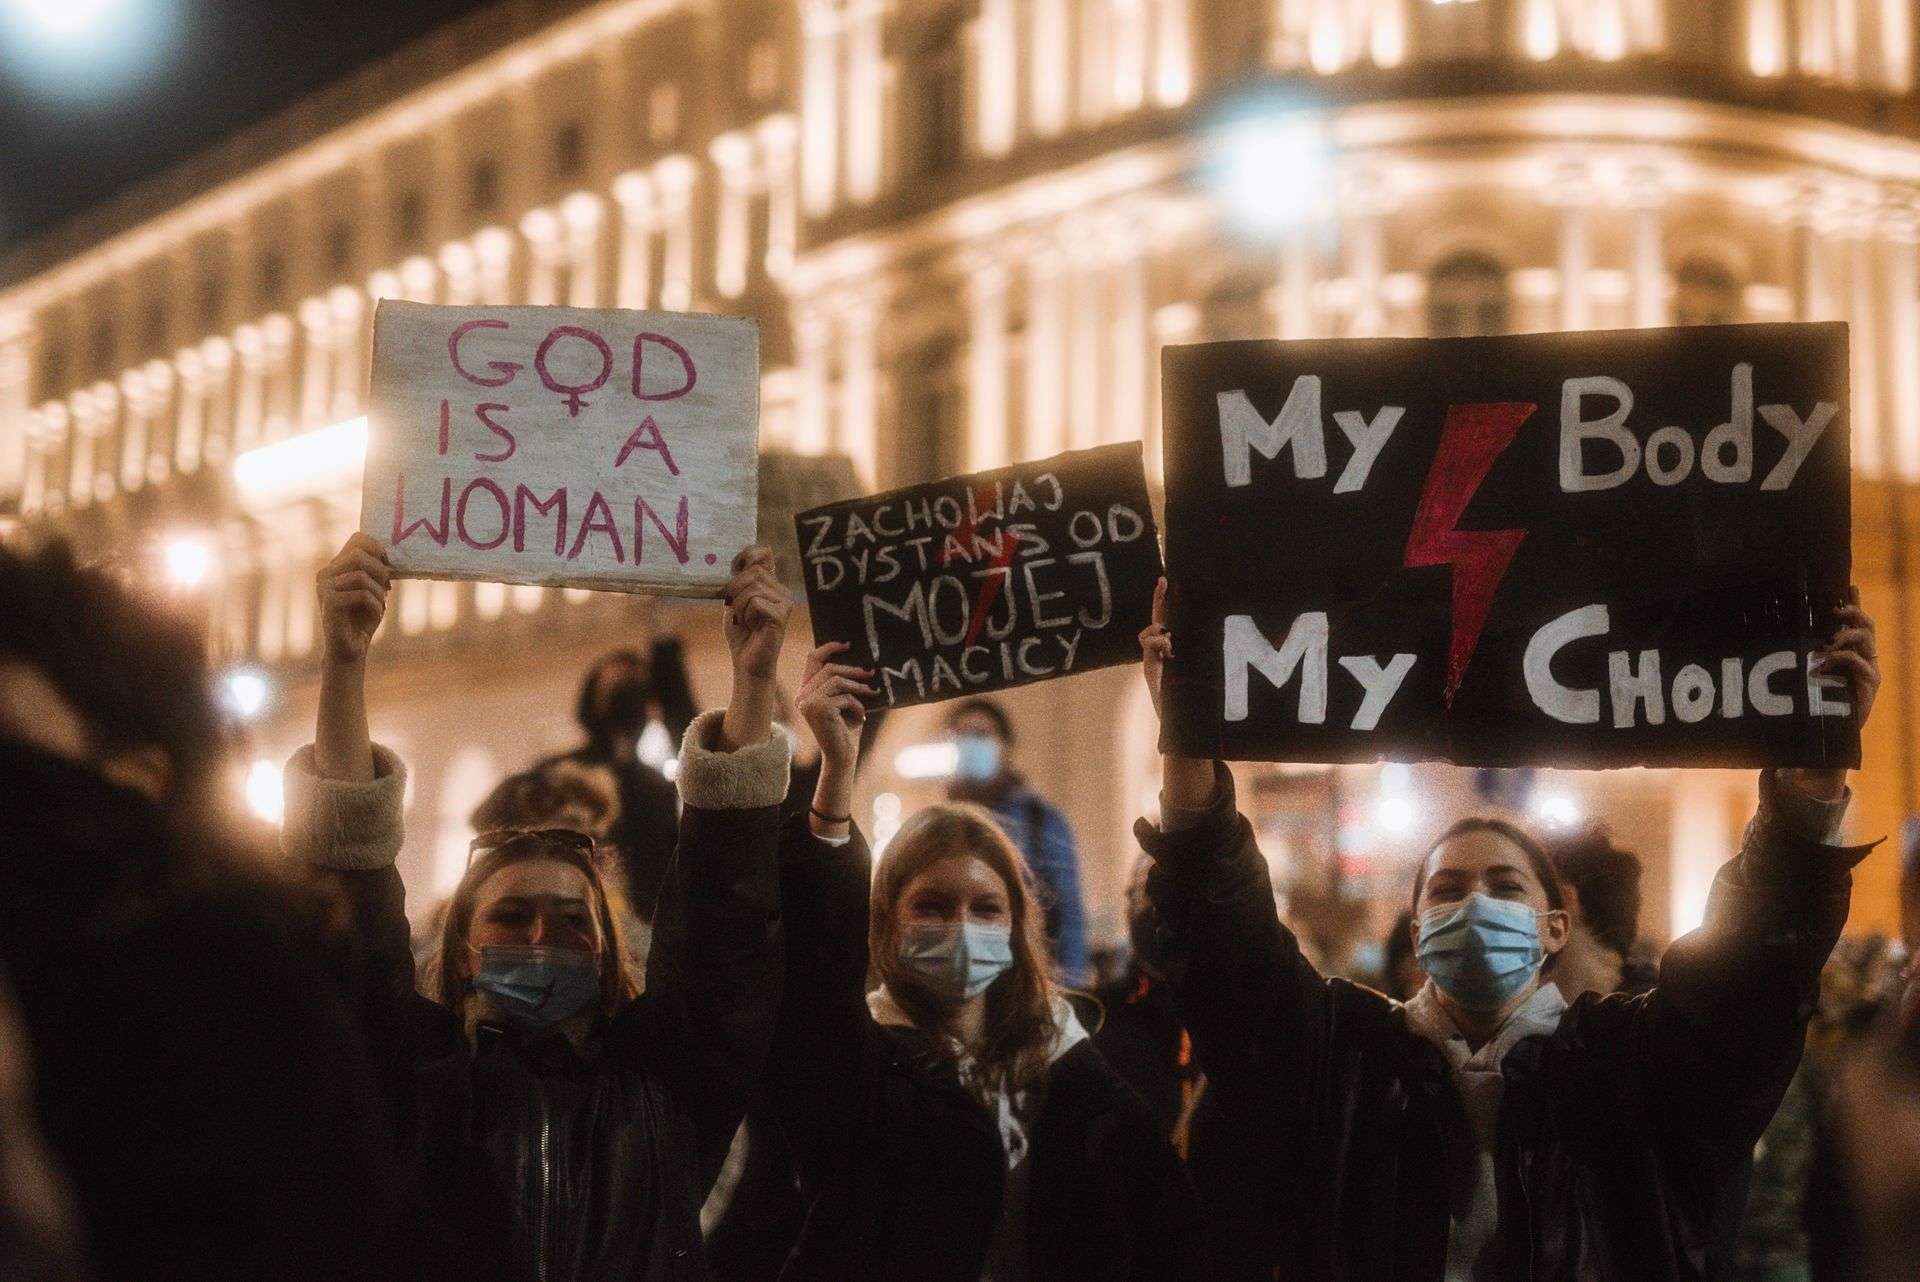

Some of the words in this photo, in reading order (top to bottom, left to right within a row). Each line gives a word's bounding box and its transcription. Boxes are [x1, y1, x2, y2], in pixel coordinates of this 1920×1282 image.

[448, 319, 698, 418] GOD
[437, 398, 517, 463] IS
[614, 415, 681, 477] A
[1216, 374, 1407, 495] My
[1558, 361, 1840, 493] Body
[390, 472, 718, 566] WOMAN.
[803, 473, 1064, 557] ZACHOWAJ
[811, 523, 1050, 592] DYSTANS
[1068, 503, 1144, 548] OD
[862, 550, 1113, 662] MOJEJ
[880, 628, 1083, 706] MACICY
[1222, 611, 1418, 731] My
